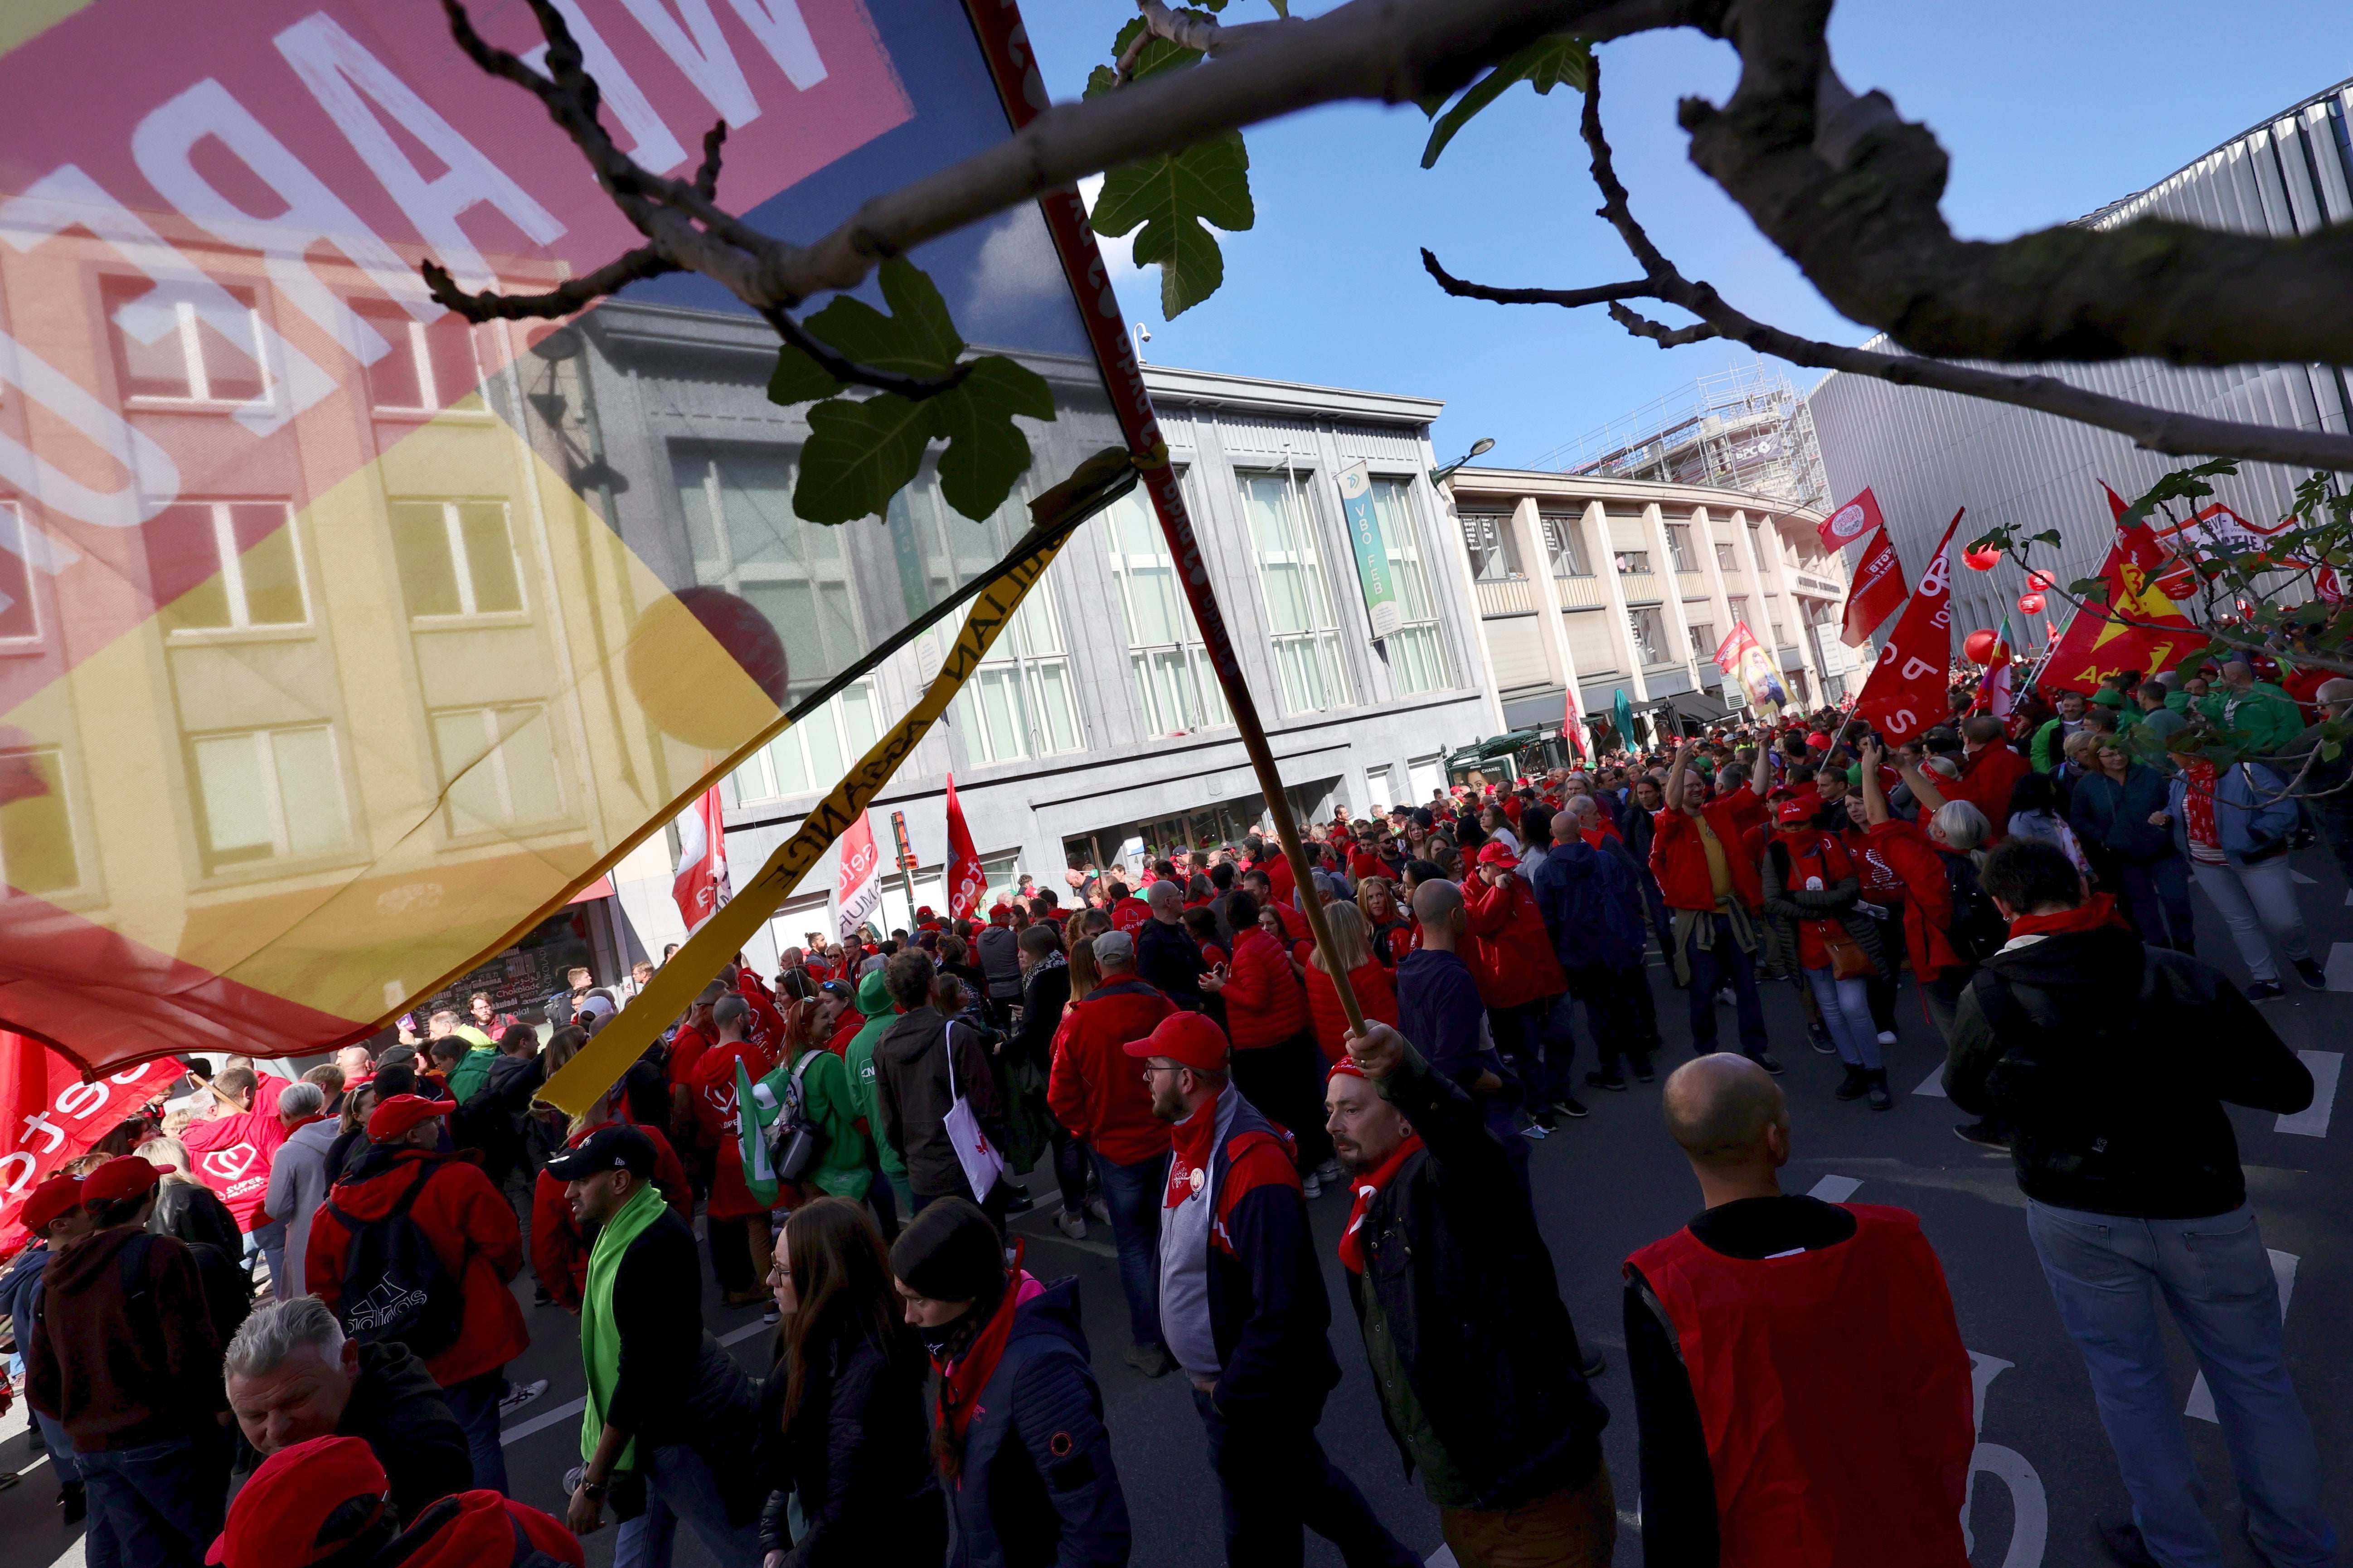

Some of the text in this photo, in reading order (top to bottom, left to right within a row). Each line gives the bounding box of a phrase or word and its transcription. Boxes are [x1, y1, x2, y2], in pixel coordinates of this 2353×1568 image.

[1355, 503, 1372, 544] VBO
[1367, 554, 1383, 595] FEB
[1135, 856, 1139, 864] 4
[861, 1066, 875, 1077] CN
[226, 1176, 264, 1194] SUPER
[348, 1290, 427, 1334] adidas
